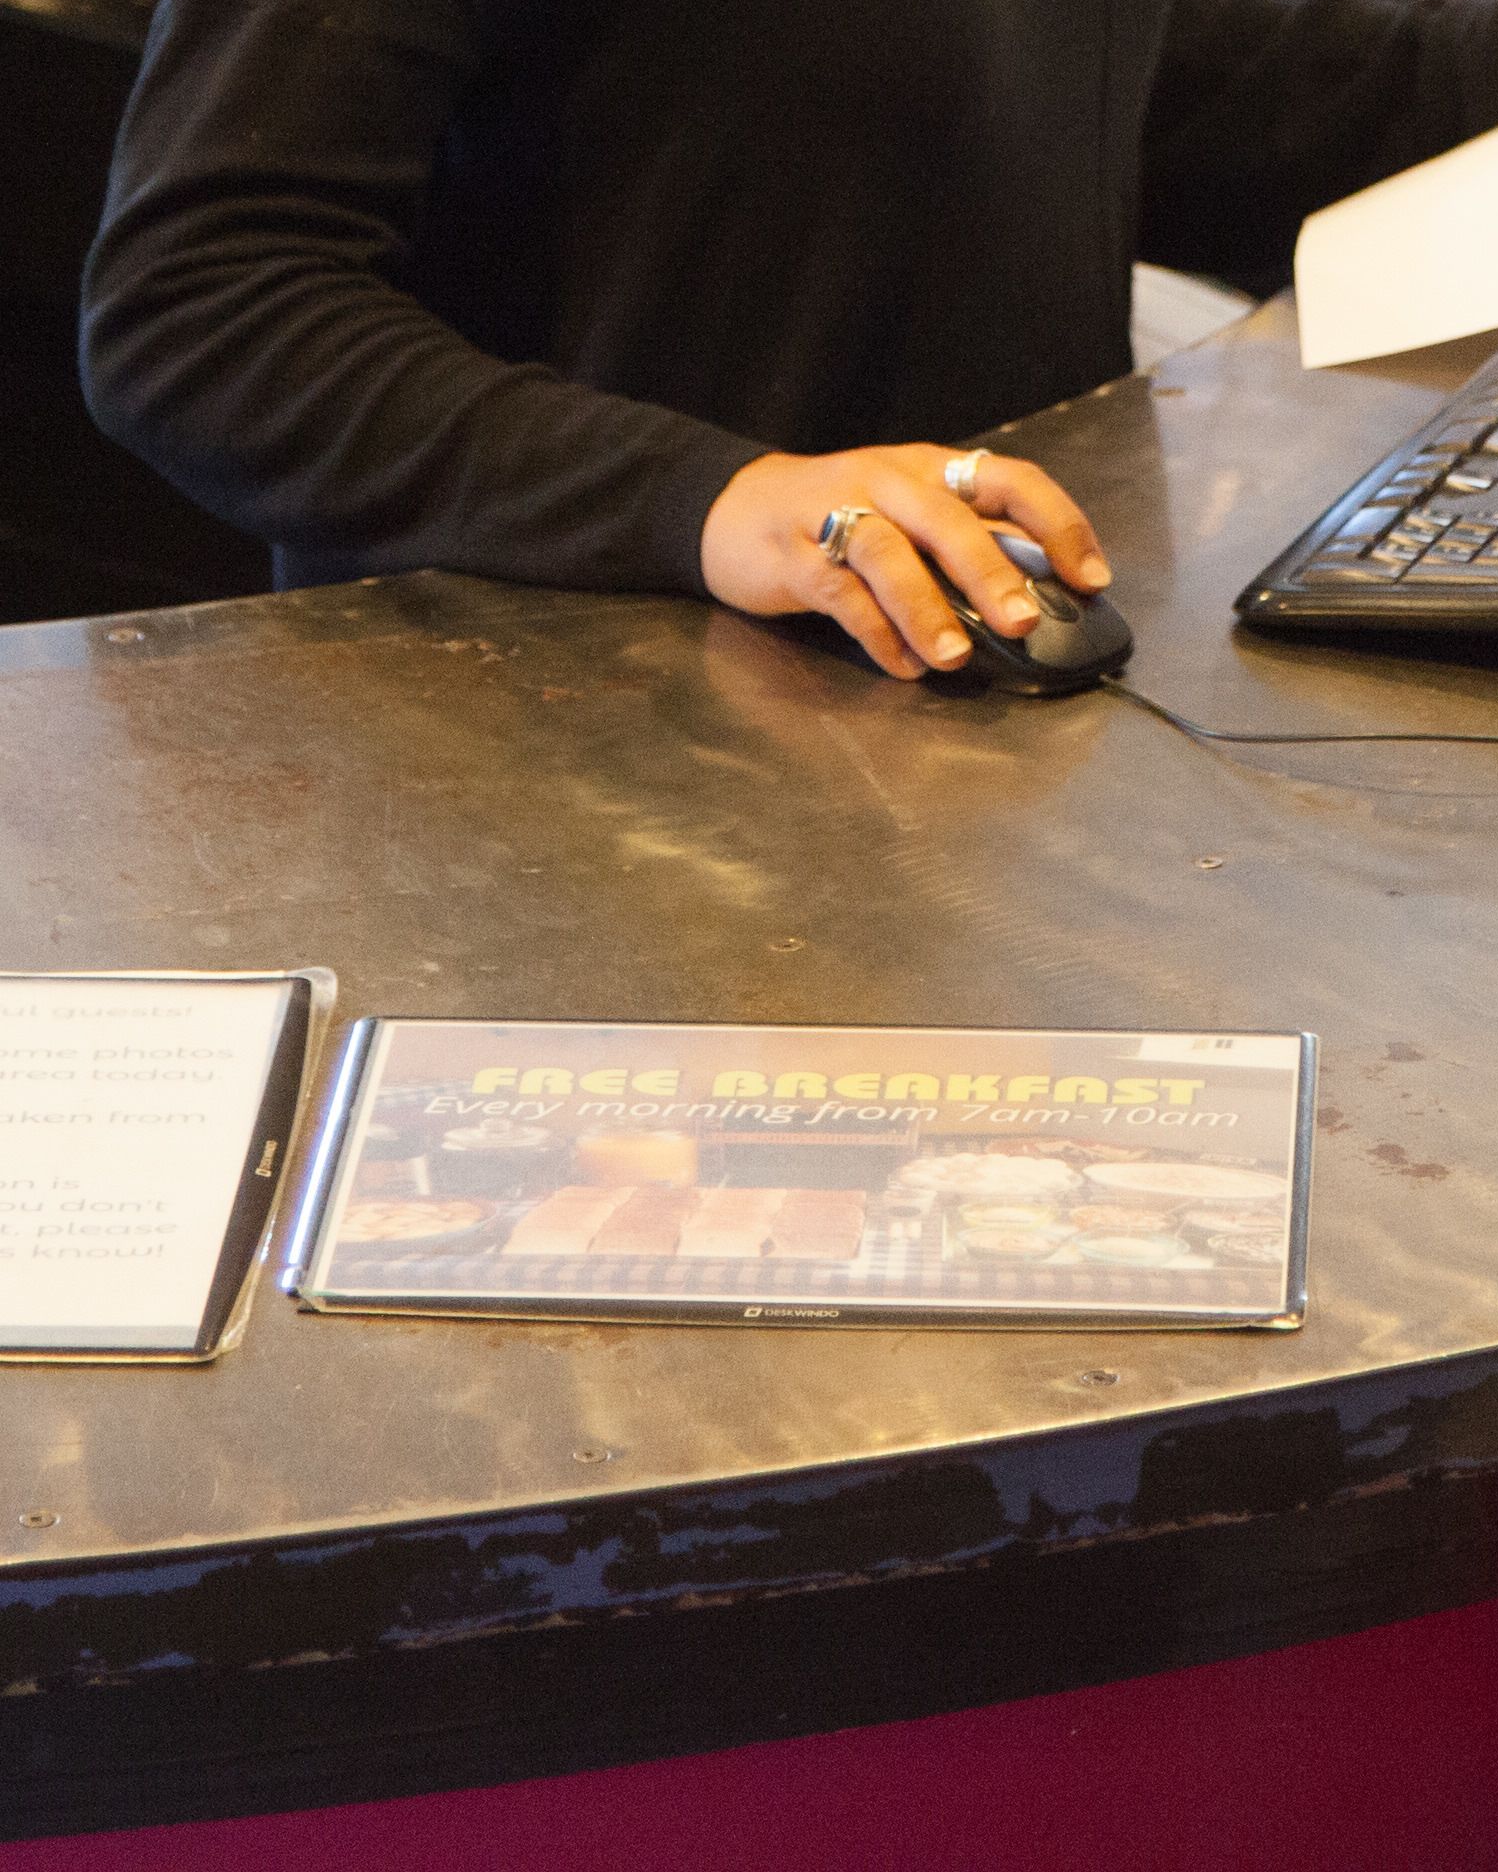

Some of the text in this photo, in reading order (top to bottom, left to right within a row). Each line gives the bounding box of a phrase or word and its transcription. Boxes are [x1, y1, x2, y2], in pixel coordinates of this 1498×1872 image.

[51, 1004, 192, 1019] guests!
[92, 1045, 234, 1062] photos
[0, 1070, 75, 1079] rea
[471, 1066, 1206, 1105] FREE BREAKFAST
[108, 1110, 207, 1124] from
[424, 1095, 1239, 1127] Every morning from 7am-10am
[52, 1176, 80, 1190] is
[59, 1198, 167, 1213] don't
[36, 1221, 178, 1238] please
[32, 1243, 164, 1259] know!
